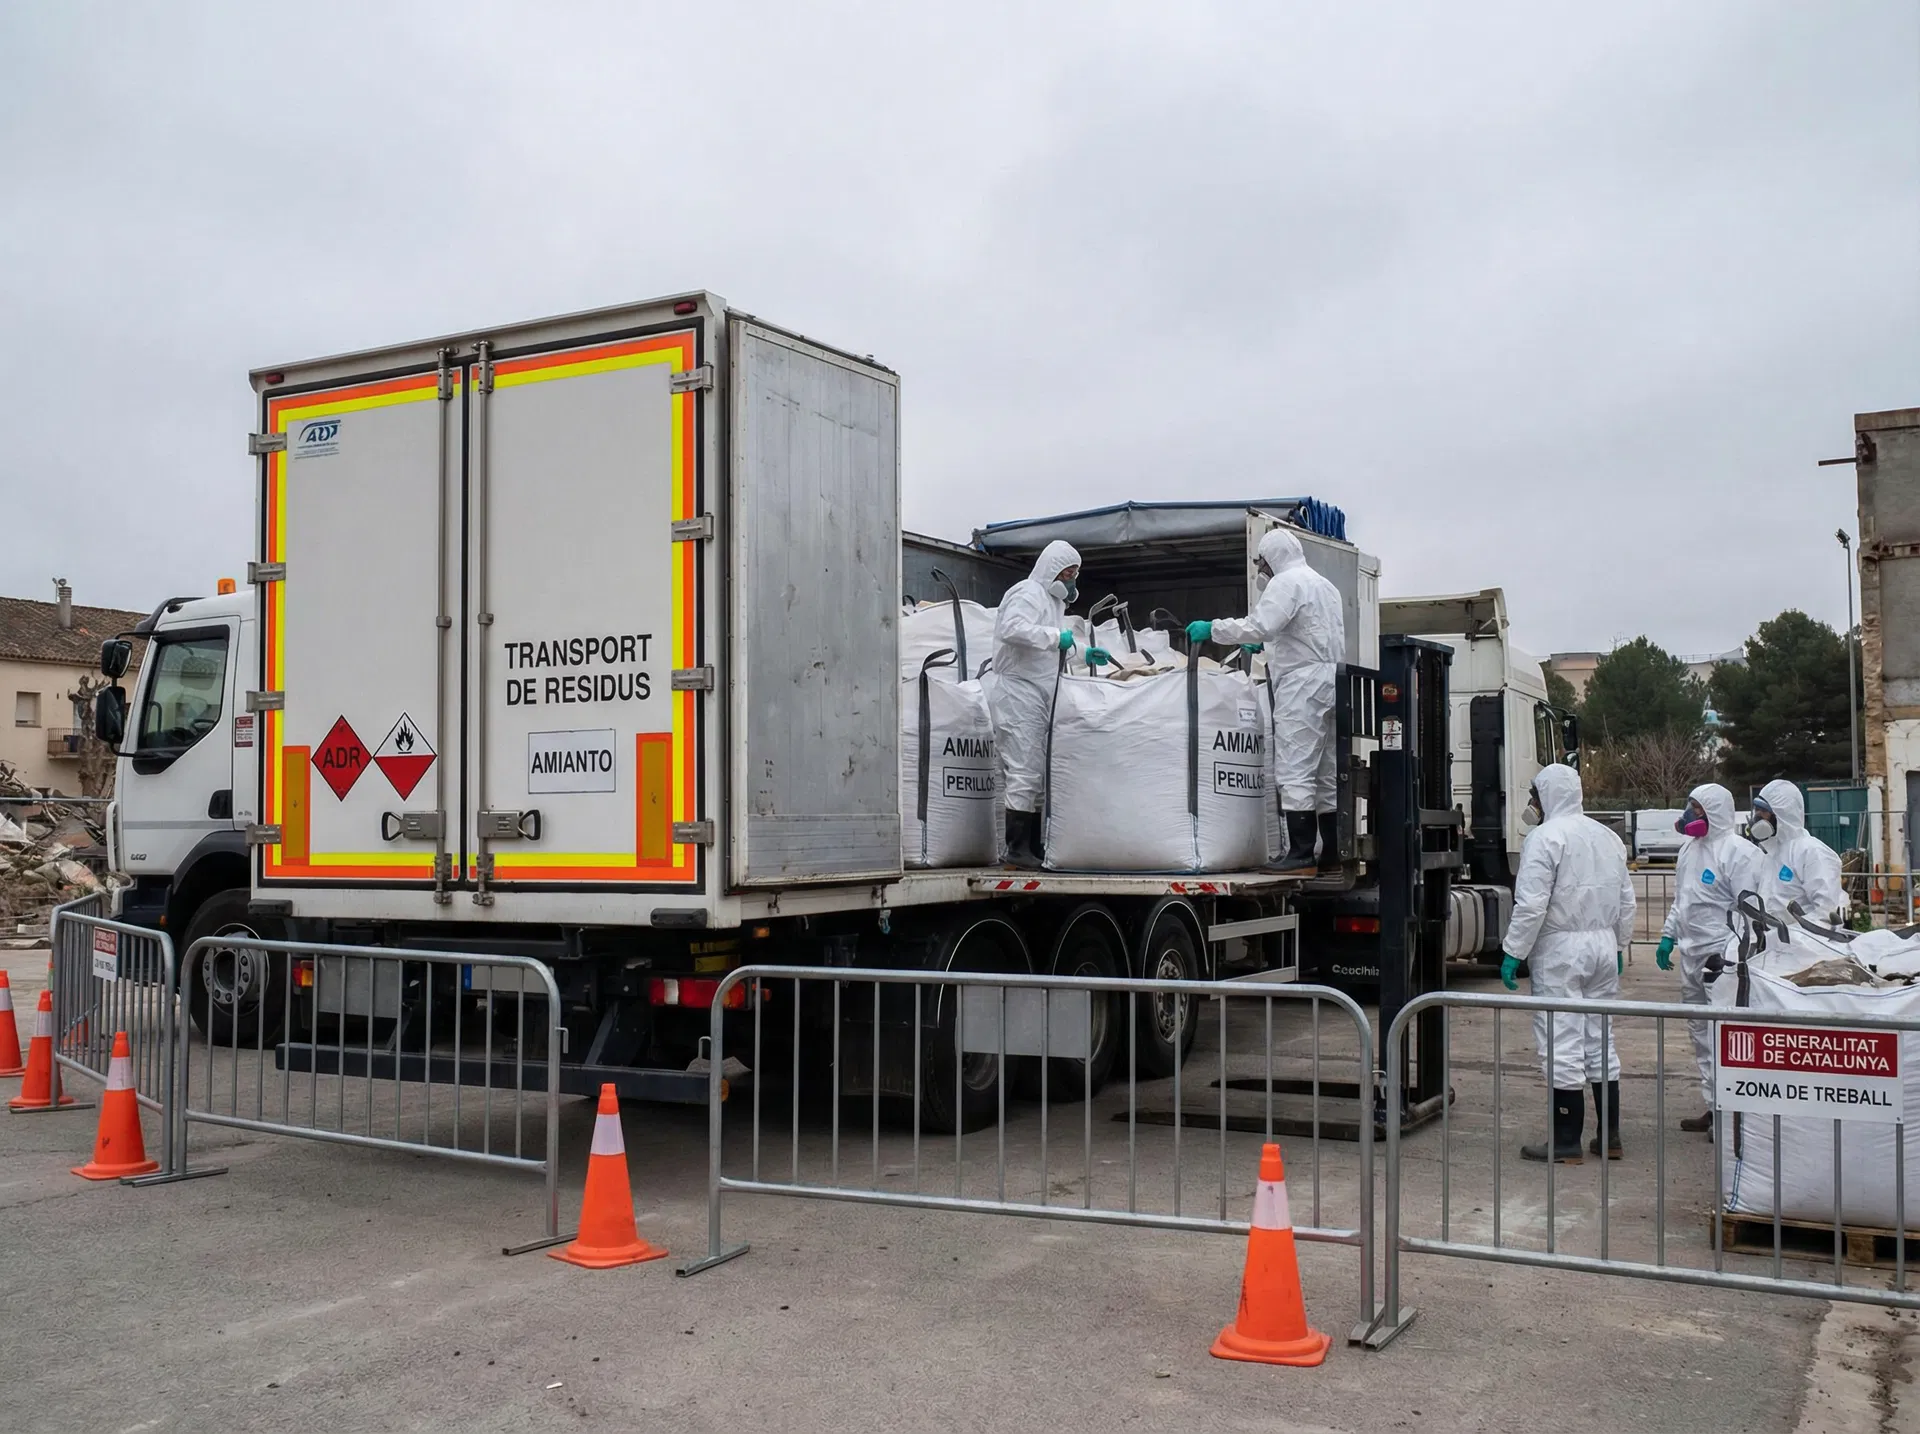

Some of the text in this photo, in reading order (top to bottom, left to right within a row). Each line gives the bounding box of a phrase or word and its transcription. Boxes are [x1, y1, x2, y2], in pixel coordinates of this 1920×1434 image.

[504, 634, 652, 669] TRANSPORT
[506, 672, 651, 706] DE RESIDUS
[322, 746, 361, 768] ADR
[531, 749, 612, 774] AMIANTO
[1762, 1033, 1879, 1053] GENERALITAT
[1763, 1050, 1889, 1071] DE CATALUNYA
[1735, 1081, 1782, 1099] ZONA
[1786, 1084, 1809, 1101] DE
[1814, 1086, 1893, 1107] TREBALL
